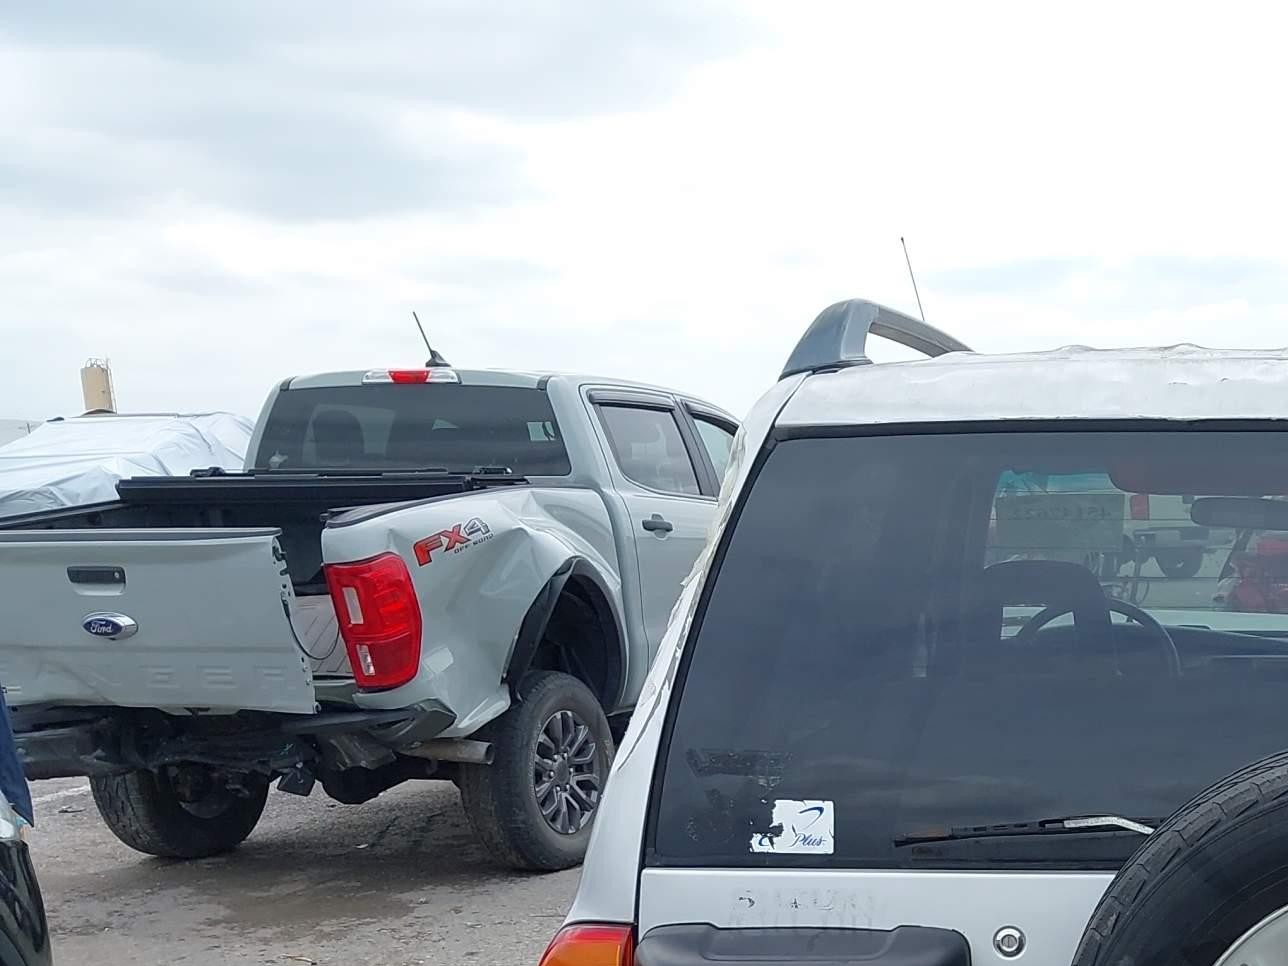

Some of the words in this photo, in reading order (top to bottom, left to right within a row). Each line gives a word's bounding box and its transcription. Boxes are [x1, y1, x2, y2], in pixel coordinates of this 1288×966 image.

[413, 517, 490, 567] FX4
[90, 620, 113, 633] Ford
[789, 833, 826, 848] Plus
